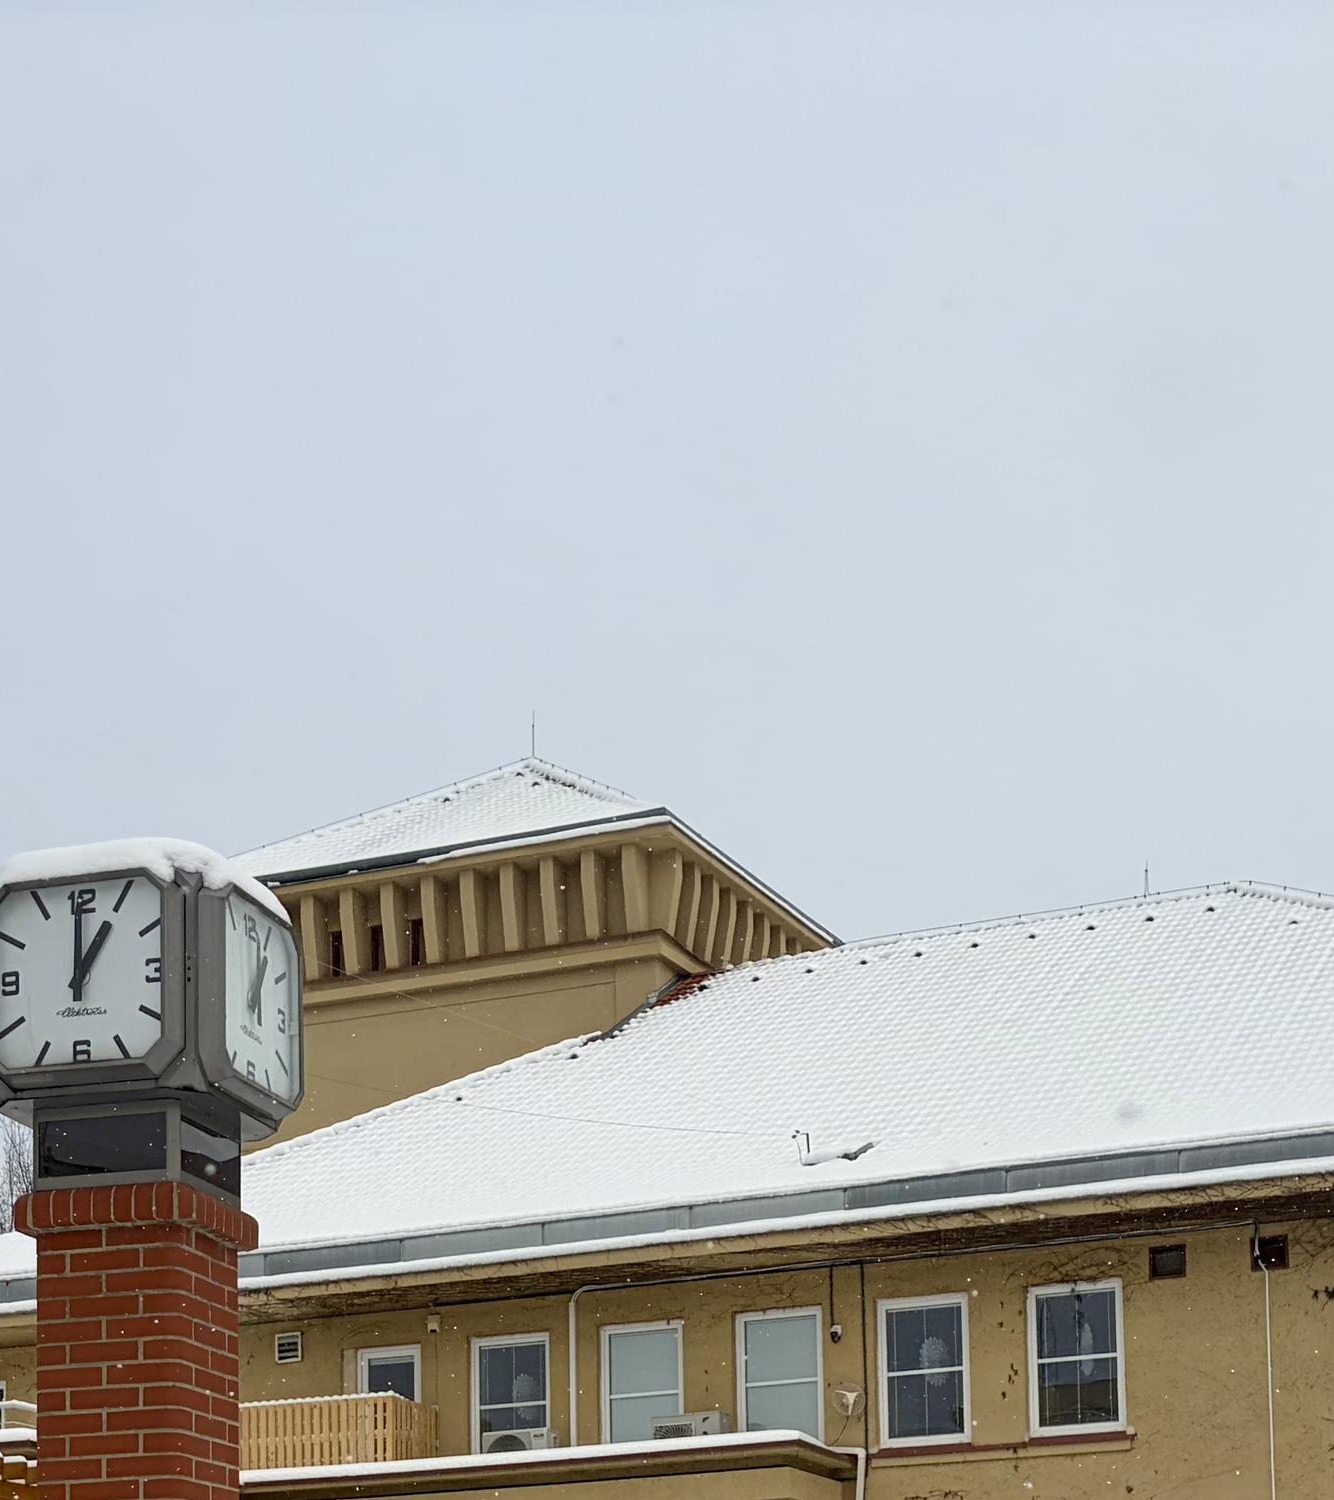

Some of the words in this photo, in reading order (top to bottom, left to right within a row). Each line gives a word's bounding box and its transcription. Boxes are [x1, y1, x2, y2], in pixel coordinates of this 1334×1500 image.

[67, 888, 96, 915] 12
[1, 970, 20, 996] 9
[145, 958, 161, 983] 3
[277, 1008, 286, 1035] 3
[73, 1039, 92, 1062] 6
[246, 1060, 256, 1081] 6
